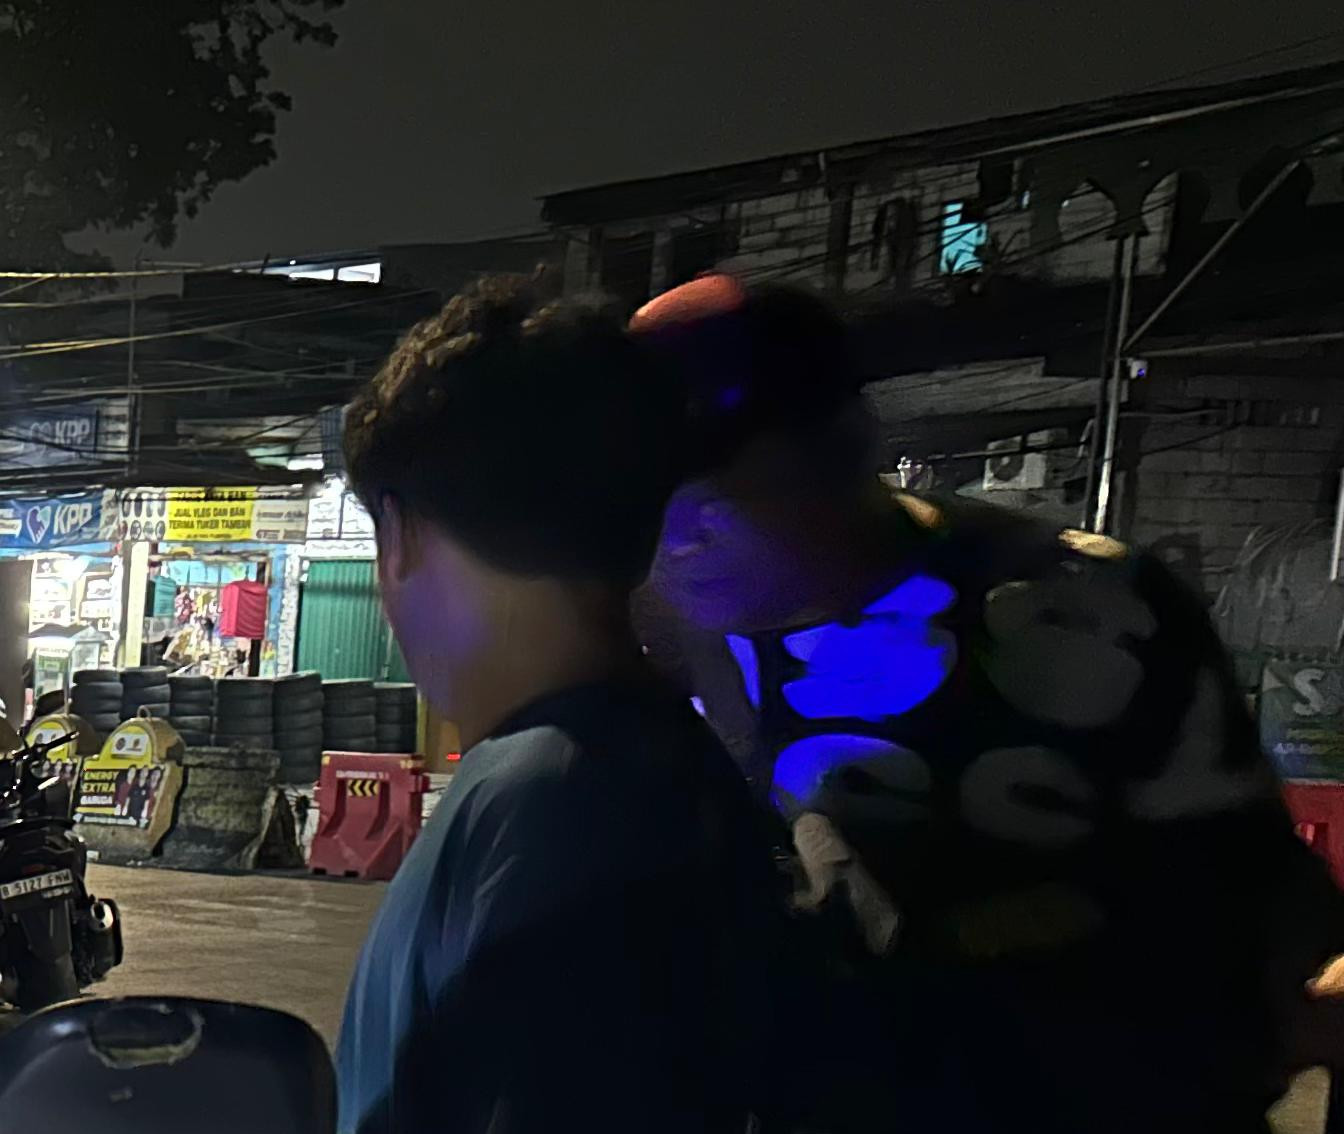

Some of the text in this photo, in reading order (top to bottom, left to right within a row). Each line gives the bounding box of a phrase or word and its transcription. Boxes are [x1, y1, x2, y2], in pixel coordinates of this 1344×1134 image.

[55, 418, 90, 445] KPP
[53, 503, 93, 535] KPP
[230, 507, 246, 517] BAN
[82, 781, 116, 793] EXTRA
